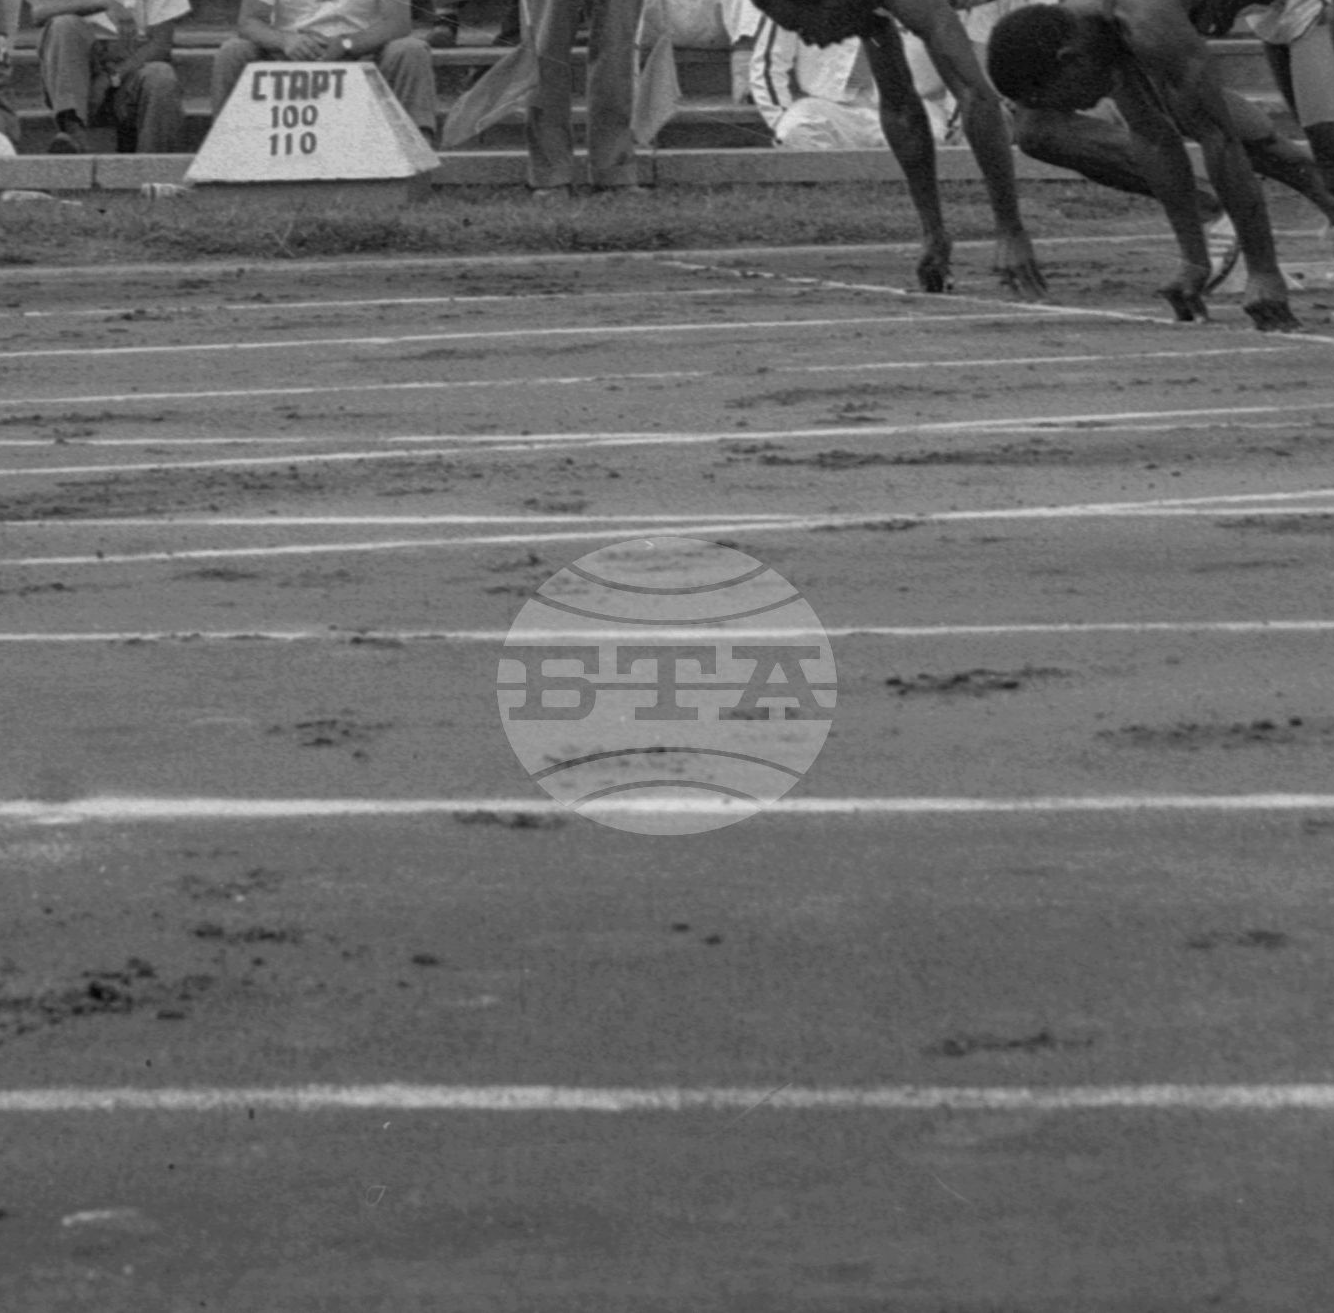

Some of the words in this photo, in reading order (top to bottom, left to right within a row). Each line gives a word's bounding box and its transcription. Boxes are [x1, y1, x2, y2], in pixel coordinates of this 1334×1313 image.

[250, 69, 348, 101] СТАРТ
[270, 105, 319, 129] 100
[269, 132, 318, 156] 110
